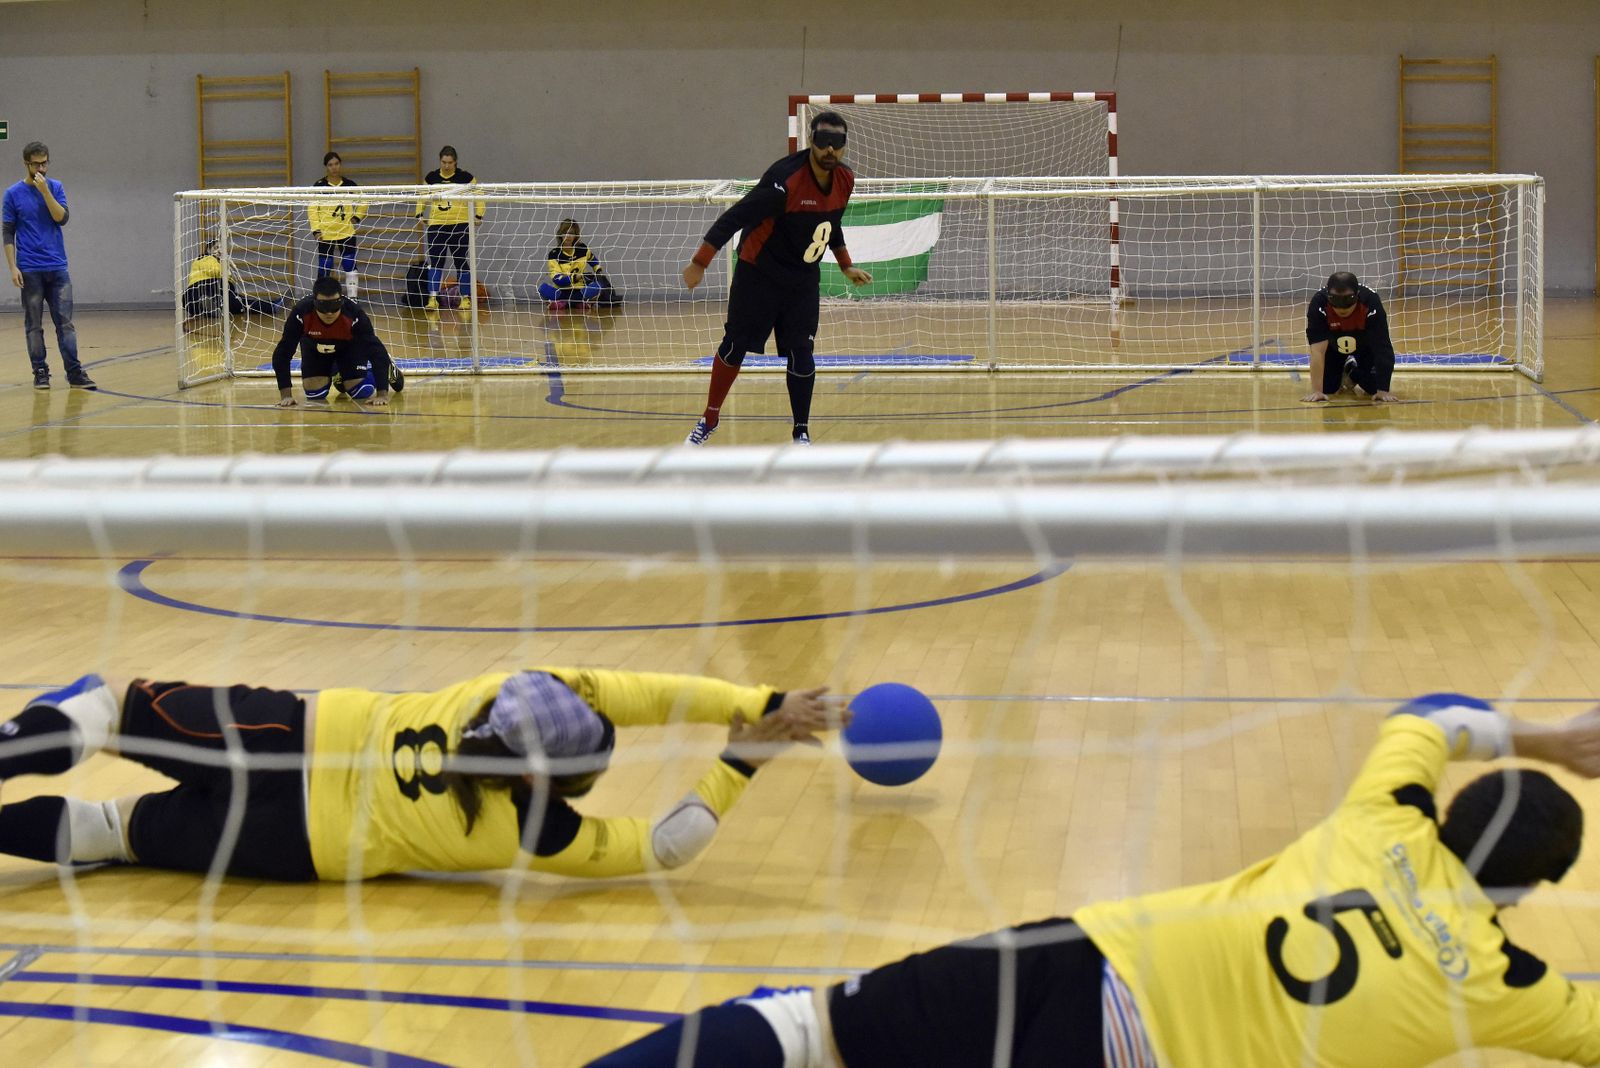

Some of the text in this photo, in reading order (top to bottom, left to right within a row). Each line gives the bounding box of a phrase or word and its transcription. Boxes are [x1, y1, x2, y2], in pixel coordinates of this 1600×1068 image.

[332, 205, 346, 221] 4
[803, 221, 832, 263] 8
[1337, 336, 1357, 354] 9
[394, 723, 448, 801] 8
[1266, 888, 1403, 1006] 5
